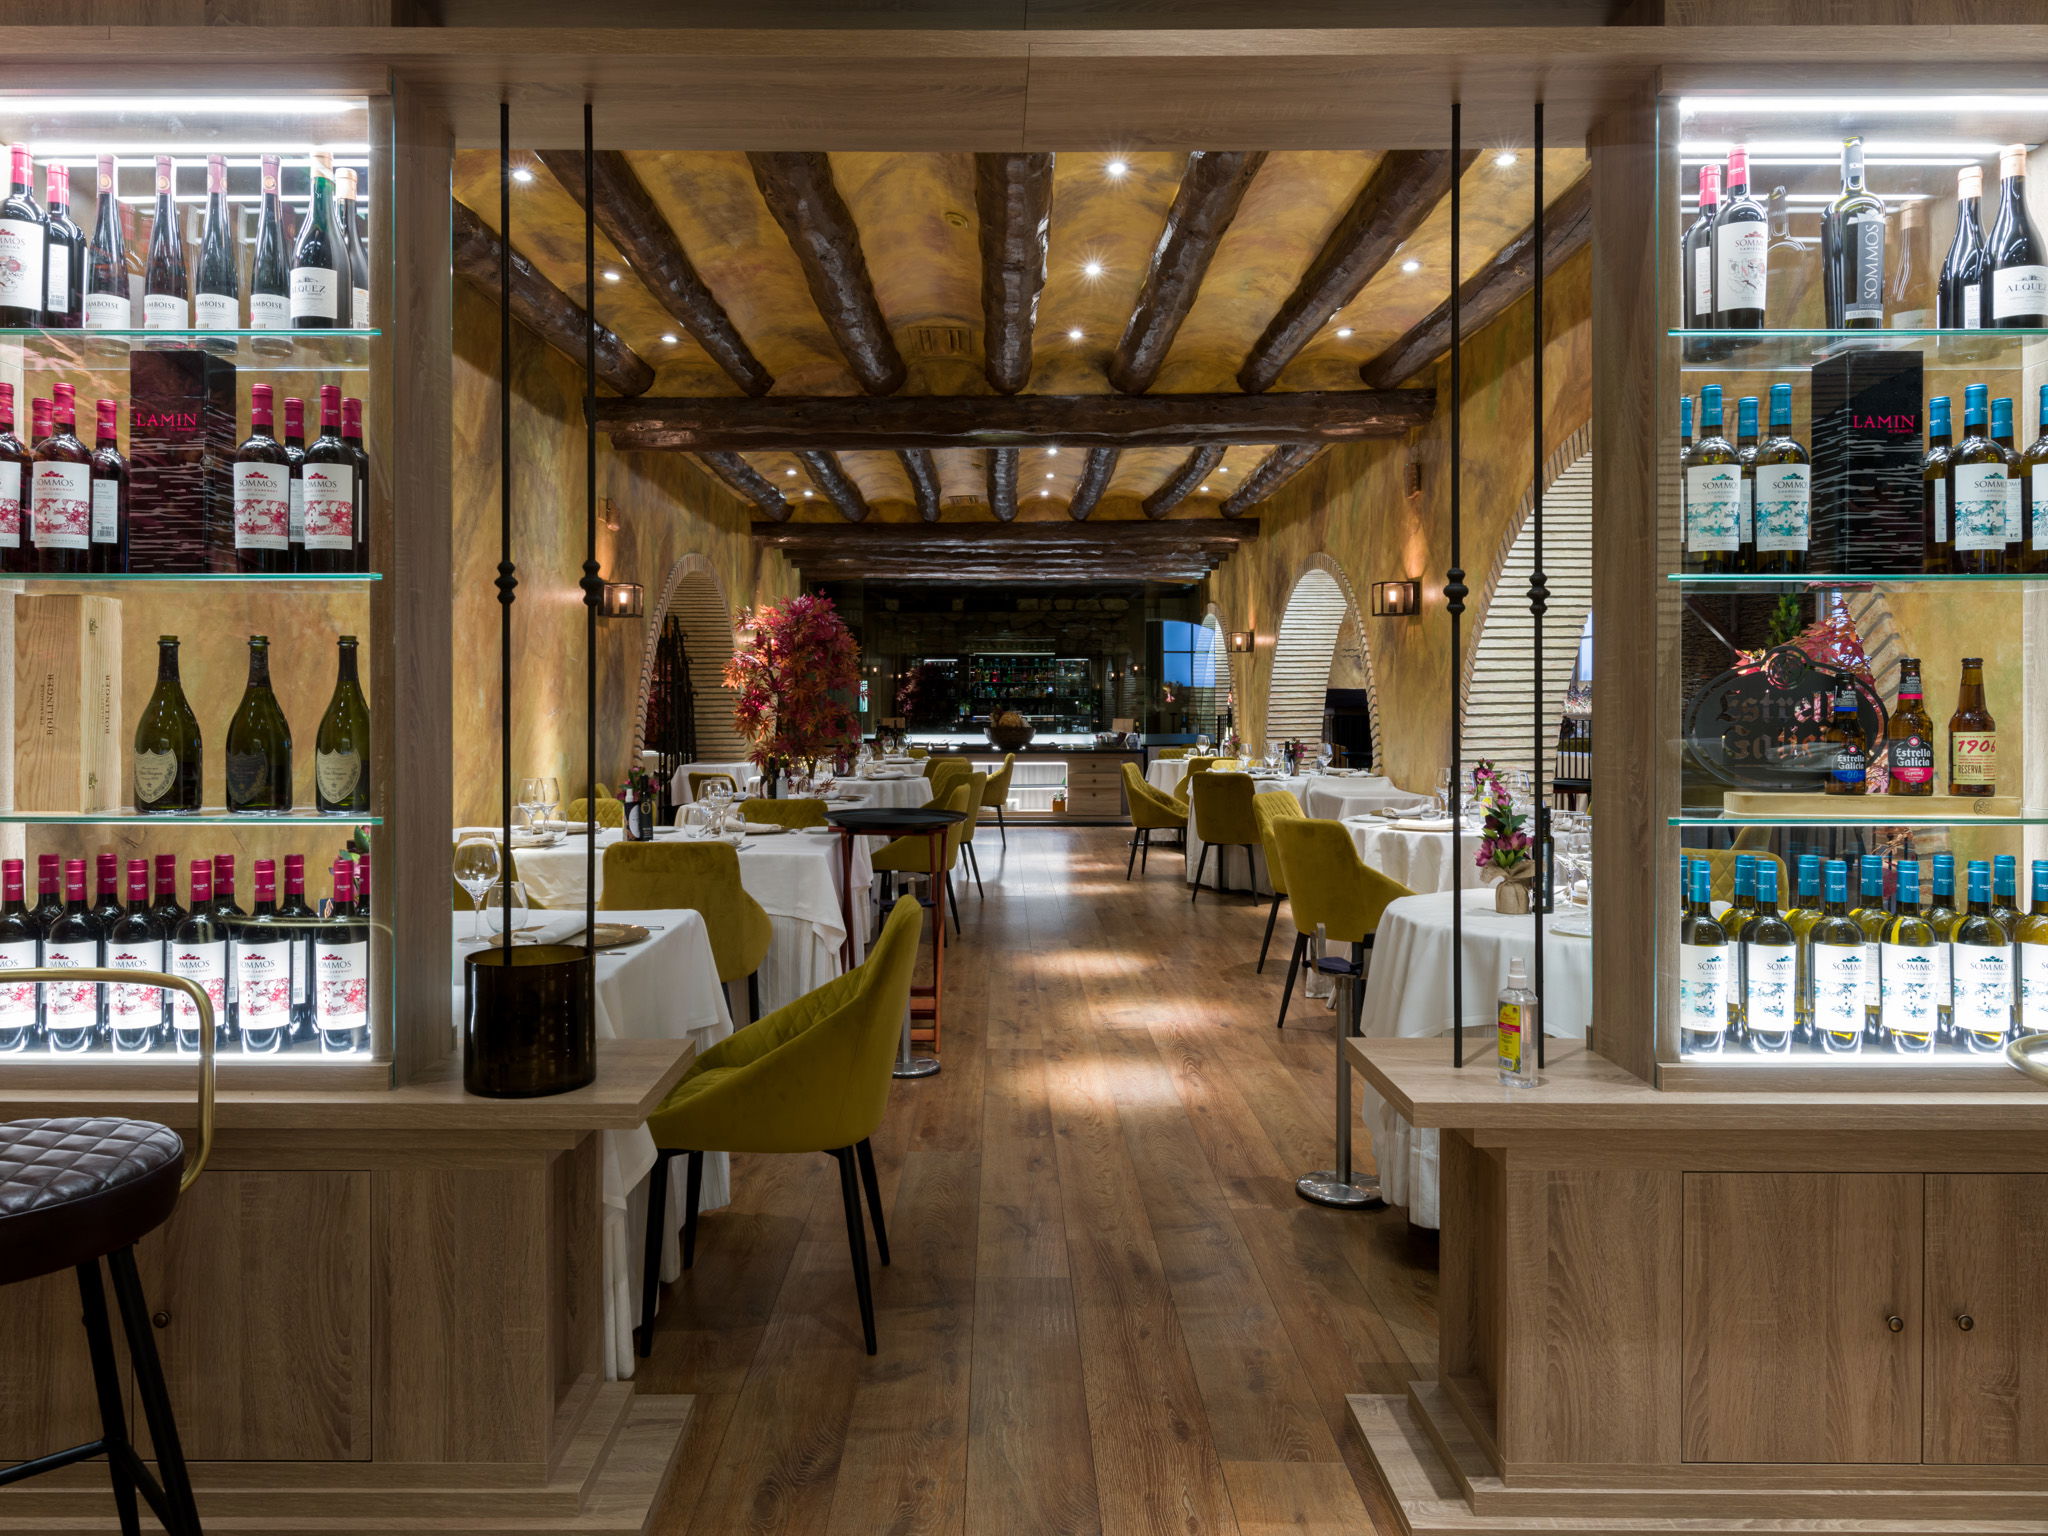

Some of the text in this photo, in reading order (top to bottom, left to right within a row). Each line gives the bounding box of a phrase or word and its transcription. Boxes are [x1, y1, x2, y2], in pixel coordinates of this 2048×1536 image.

[1864, 223, 1879, 300] SOMMOS
[135, 413, 198, 427] LAMIN
[1853, 415, 1916, 429] LAMIN
[1702, 481, 1738, 490] SOMMO
[46, 673, 54, 736] BOLLINGER
[1715, 690, 1836, 723] Estrell
[1895, 747, 1931, 758] Estrella
[1957, 739, 1996, 754] 1906
[1896, 757, 1930, 767] Galicia
[1958, 764, 1982, 774] RESERVA
